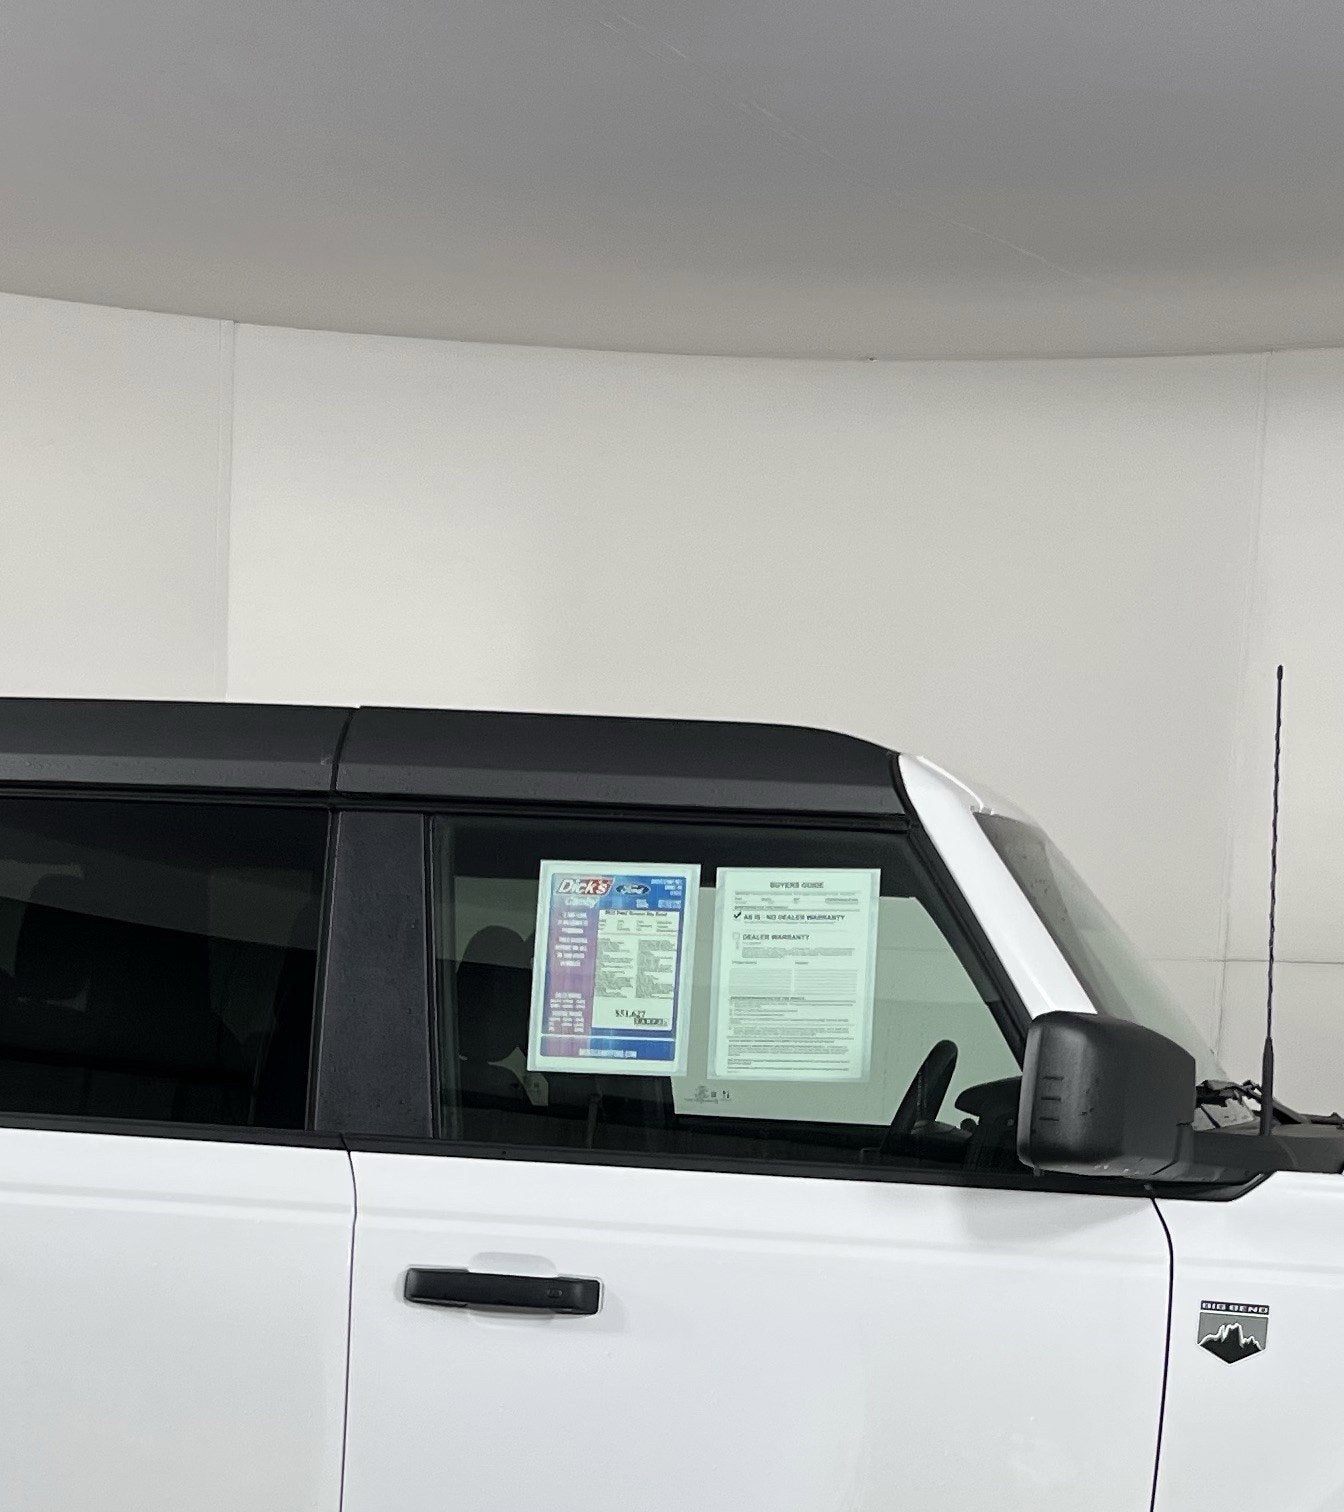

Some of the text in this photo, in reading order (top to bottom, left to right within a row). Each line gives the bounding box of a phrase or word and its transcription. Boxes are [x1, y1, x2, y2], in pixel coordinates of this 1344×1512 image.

[769, 881, 824, 889] BUYERS GUIDE
[742, 933, 810, 941] DEALER WARRANTY
[1202, 1302, 1268, 1313] BIG BEND
